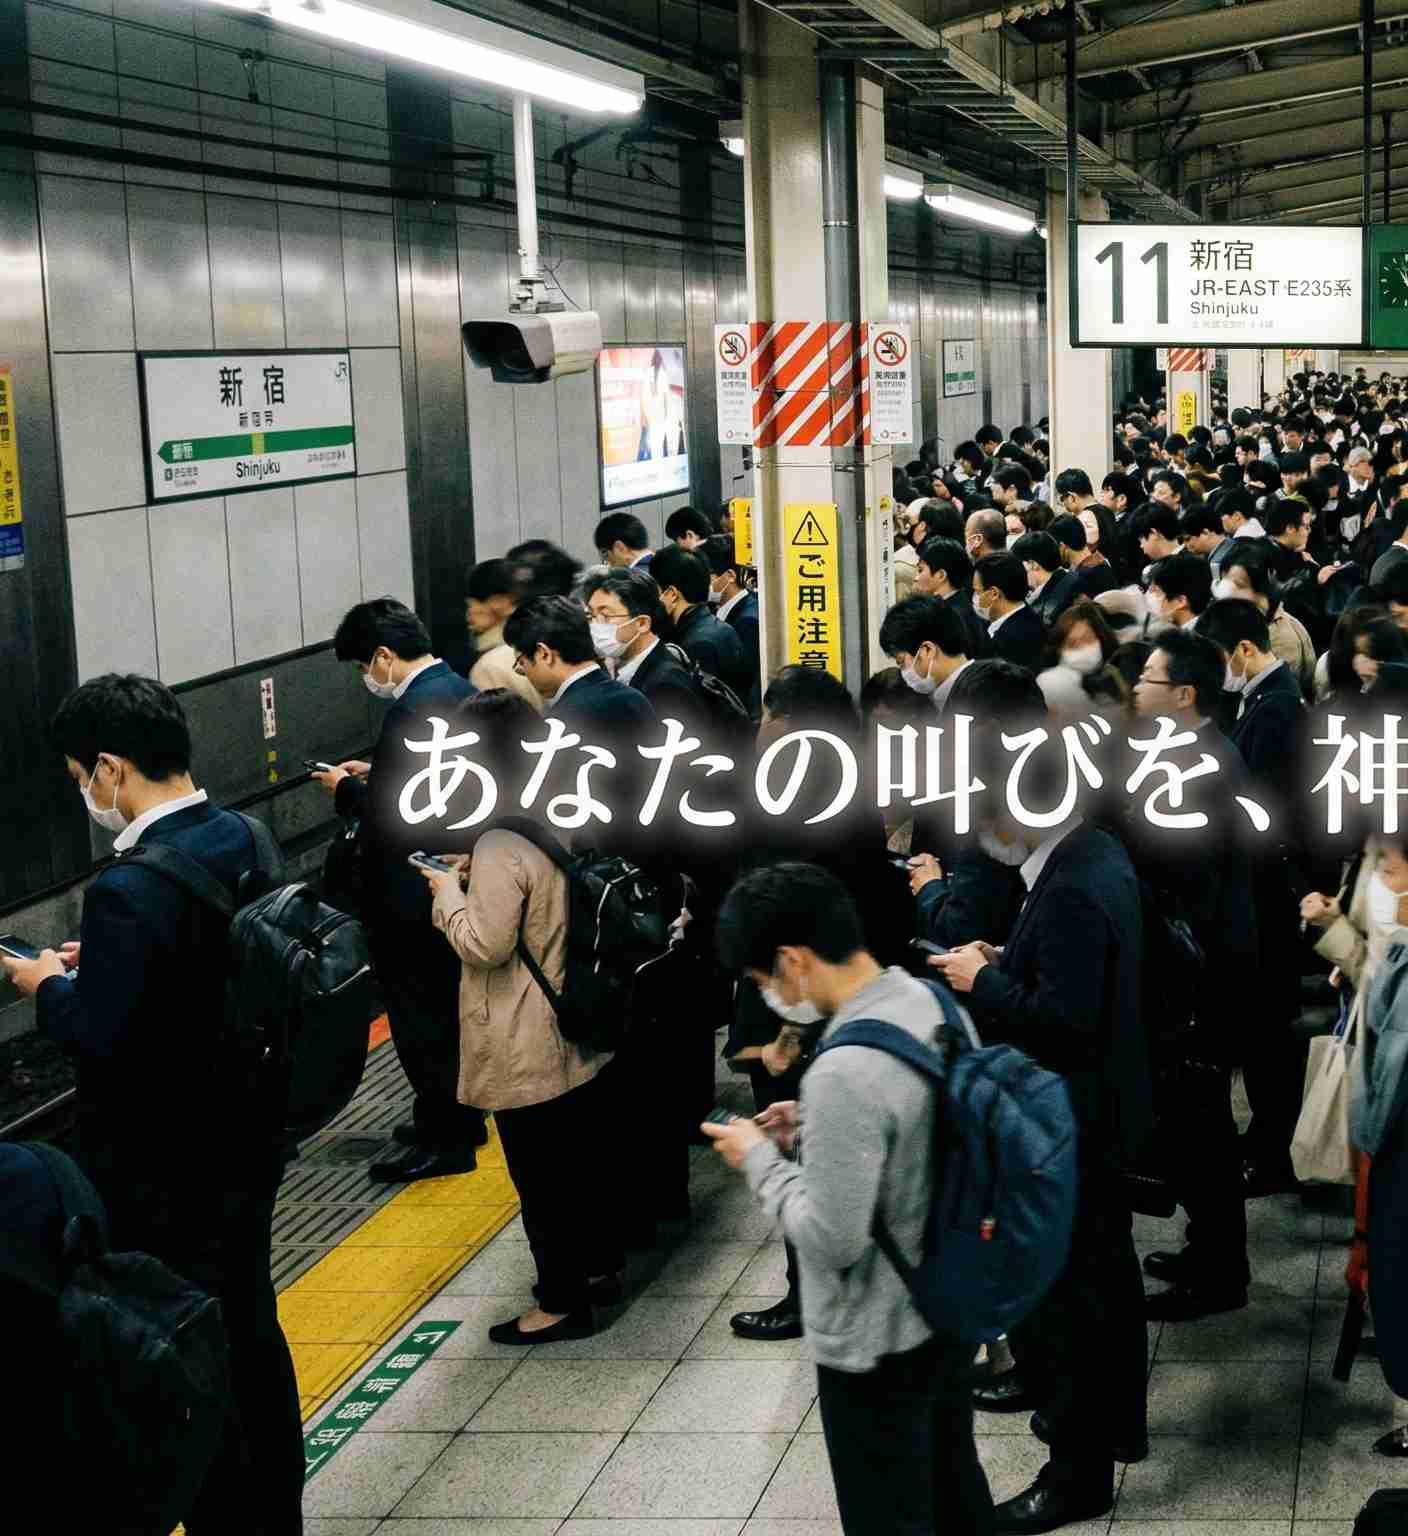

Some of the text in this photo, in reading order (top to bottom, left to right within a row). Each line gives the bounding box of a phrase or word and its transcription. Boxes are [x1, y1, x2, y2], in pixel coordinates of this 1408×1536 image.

[1190, 239, 1254, 271] 新宿
[1095, 241, 1169, 324] 11
[1190, 301, 1258, 318] Shinjuku
[219, 364, 285, 407] 新宿
[236, 458, 281, 481] Shinjuku
